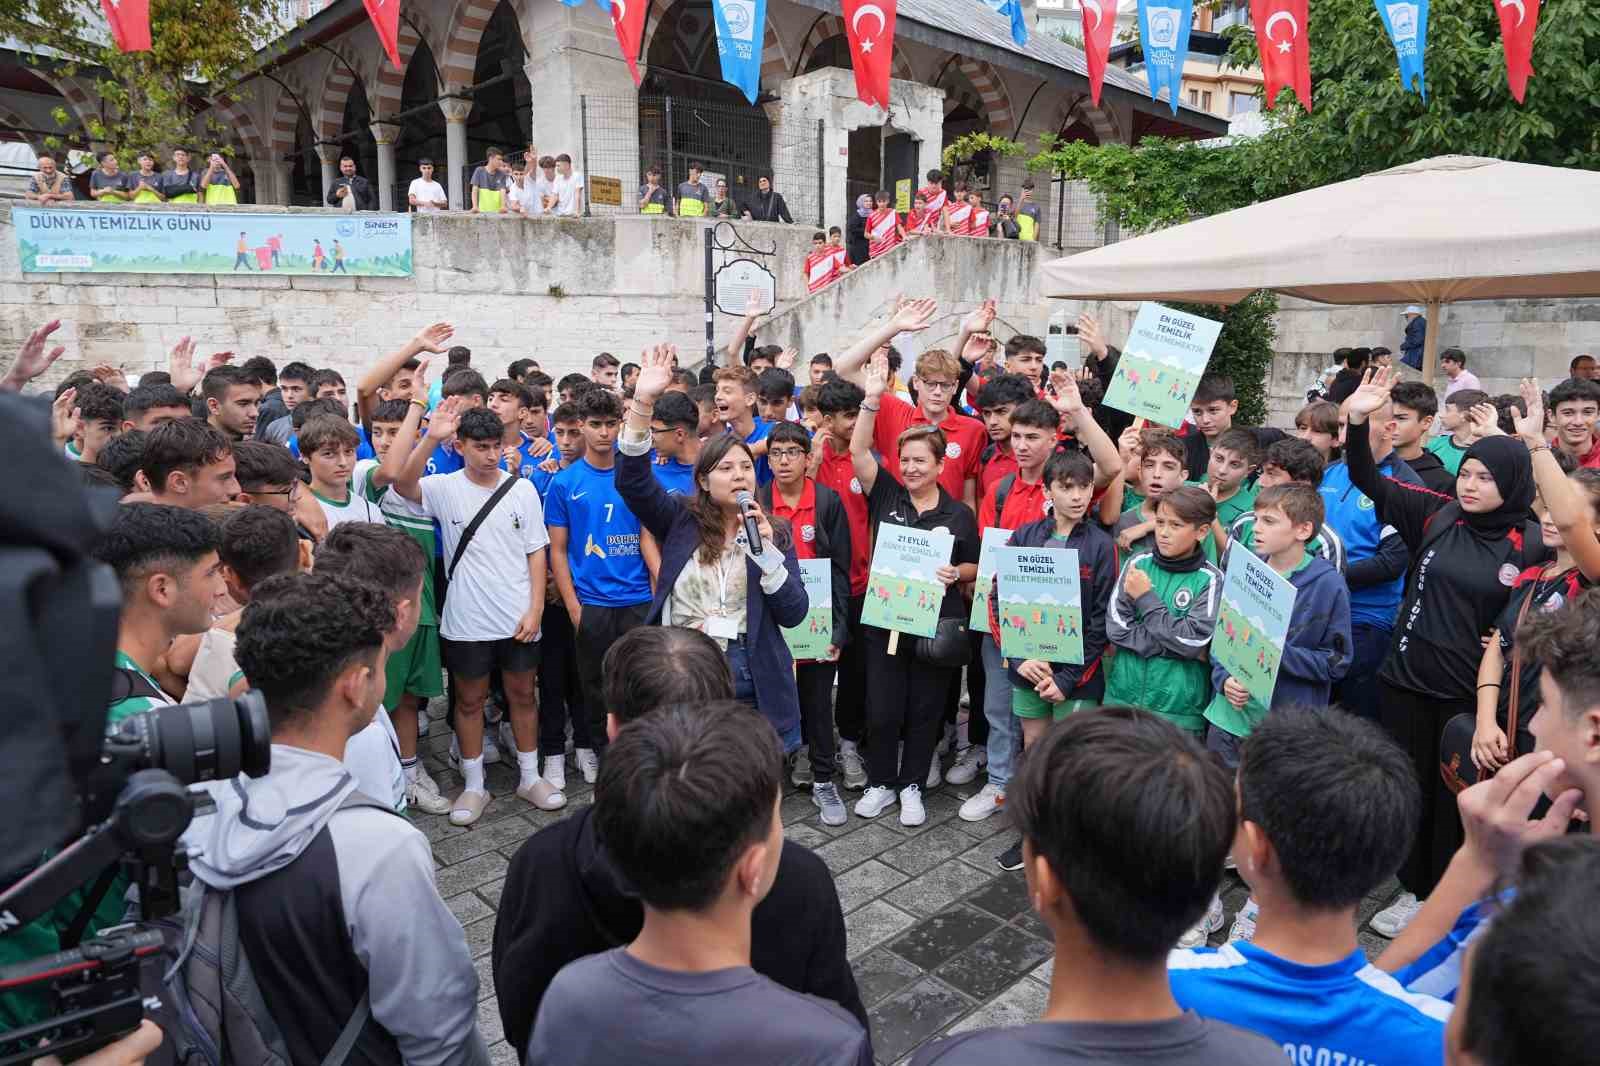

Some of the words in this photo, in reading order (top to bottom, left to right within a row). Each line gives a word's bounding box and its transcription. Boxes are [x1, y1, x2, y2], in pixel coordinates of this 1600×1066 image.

[30, 213, 85, 229] DÜNYA
[88, 213, 163, 231] TEMİZLİK
[167, 214, 212, 231] GÜNÜ
[1160, 314, 1171, 325] EN
[1172, 317, 1196, 331] GÜZEL
[1157, 324, 1193, 341] TEMİZLİK
[426, 457, 437, 474] 6
[604, 503, 614, 523] 7
[897, 535, 906, 543] 21
[907, 535, 931, 547] EYLÜL
[1017, 555, 1028, 563] EN
[1030, 554, 1055, 564] GÜZEL
[1019, 564, 1055, 574] TEMİZLİK
[1247, 563, 1255, 573] EN
[1255, 570, 1274, 591] GÜZEL
[1245, 573, 1272, 601] TEMİZLİK
